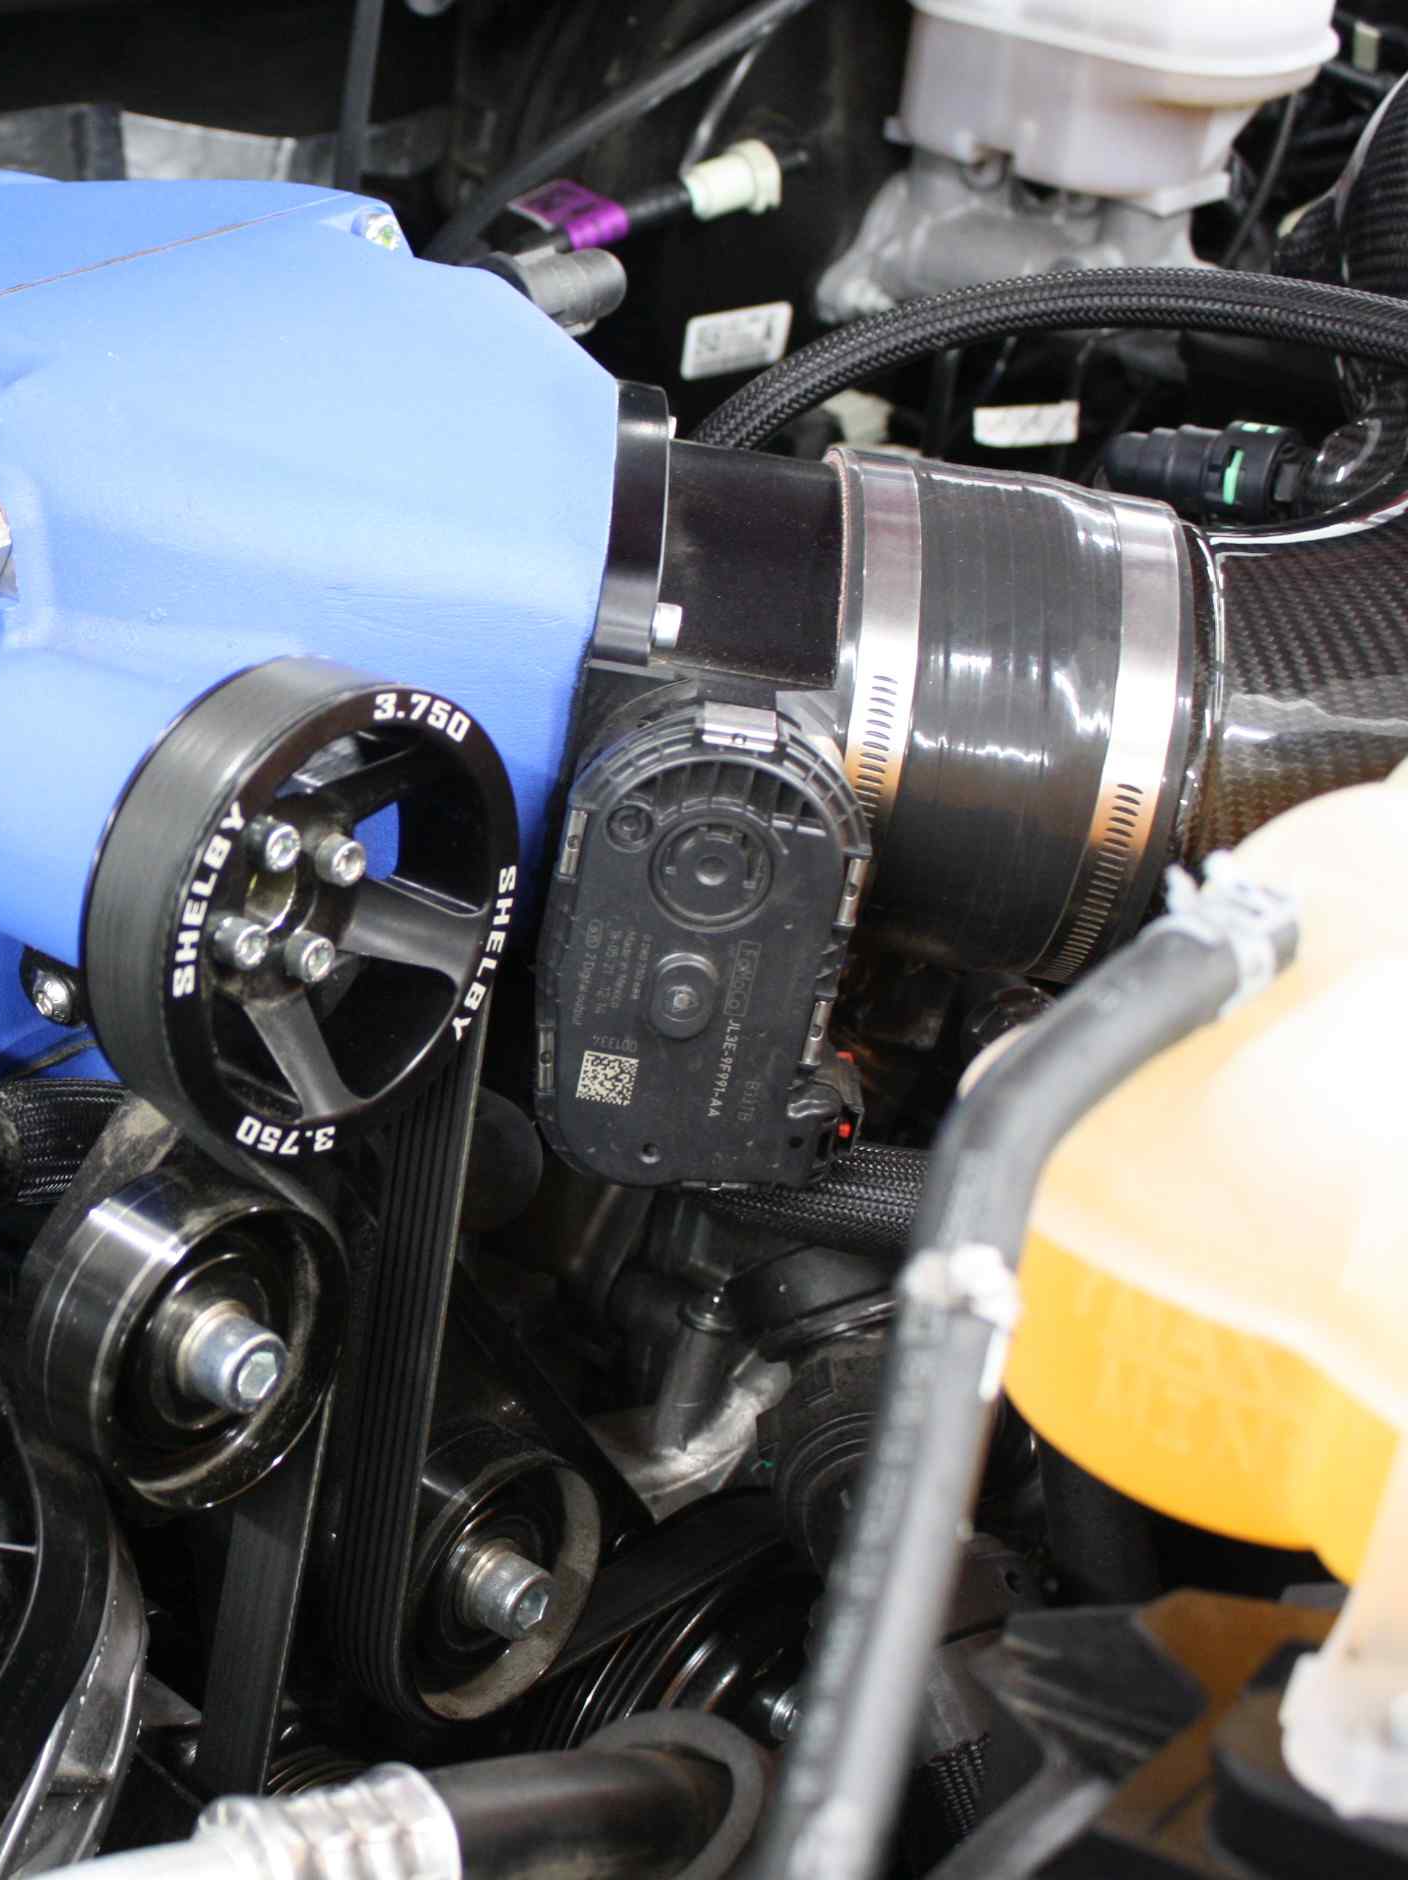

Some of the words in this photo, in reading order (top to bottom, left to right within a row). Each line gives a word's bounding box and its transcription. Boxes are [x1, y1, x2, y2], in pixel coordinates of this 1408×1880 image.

[373, 692, 472, 743] 3.750
[172, 801, 246, 998] SHELBY
[452, 865, 517, 1041] SHELBY
[707, 1018, 741, 1117] JL3E-9F991-AA
[235, 1115, 336, 1155] 3.750
